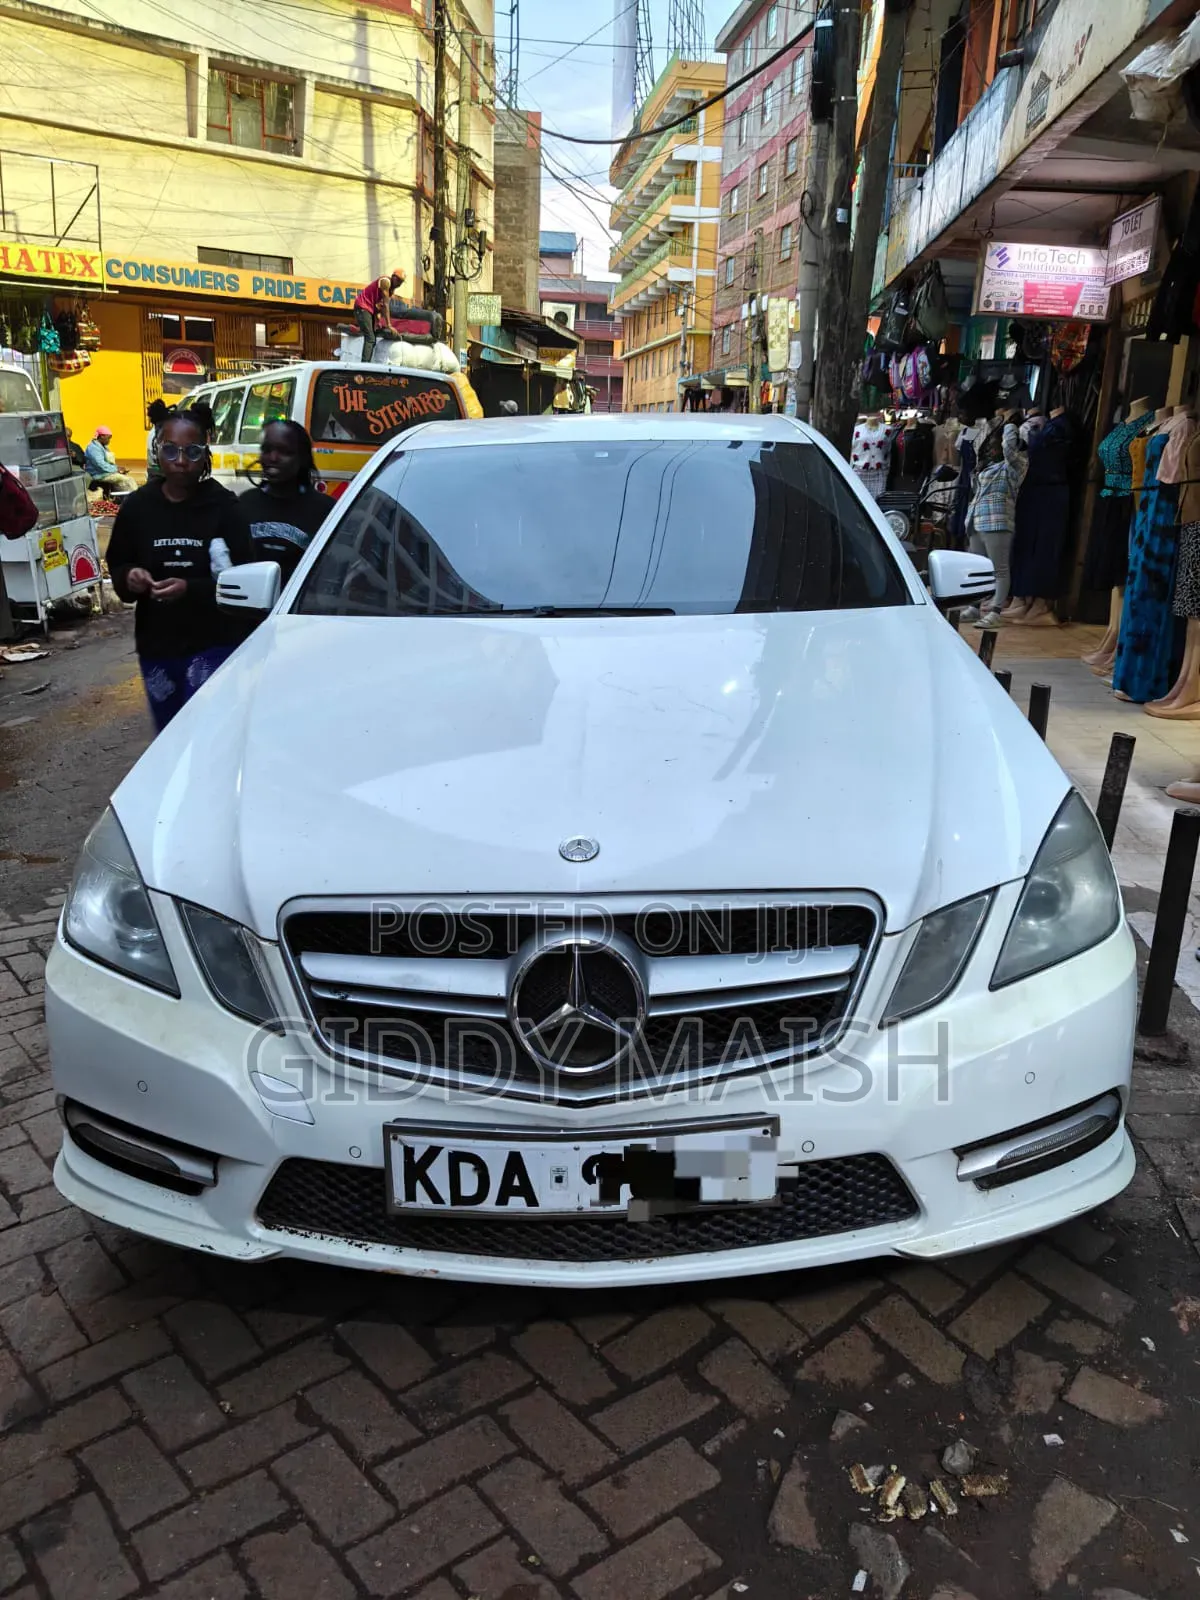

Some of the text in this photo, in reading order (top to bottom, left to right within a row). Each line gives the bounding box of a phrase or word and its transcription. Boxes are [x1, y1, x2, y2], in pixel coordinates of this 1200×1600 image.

[1017, 247, 1086, 265] InfoTech
[1017, 262, 1067, 273] solutions
[105, 258, 240, 292] CONSUMERS
[252, 275, 307, 301] PRIDE
[317, 285, 364, 305] CAF
[332, 384, 369, 413] THE
[366, 388, 446, 435] STEWARD
[403, 1145, 540, 1208] KDA
